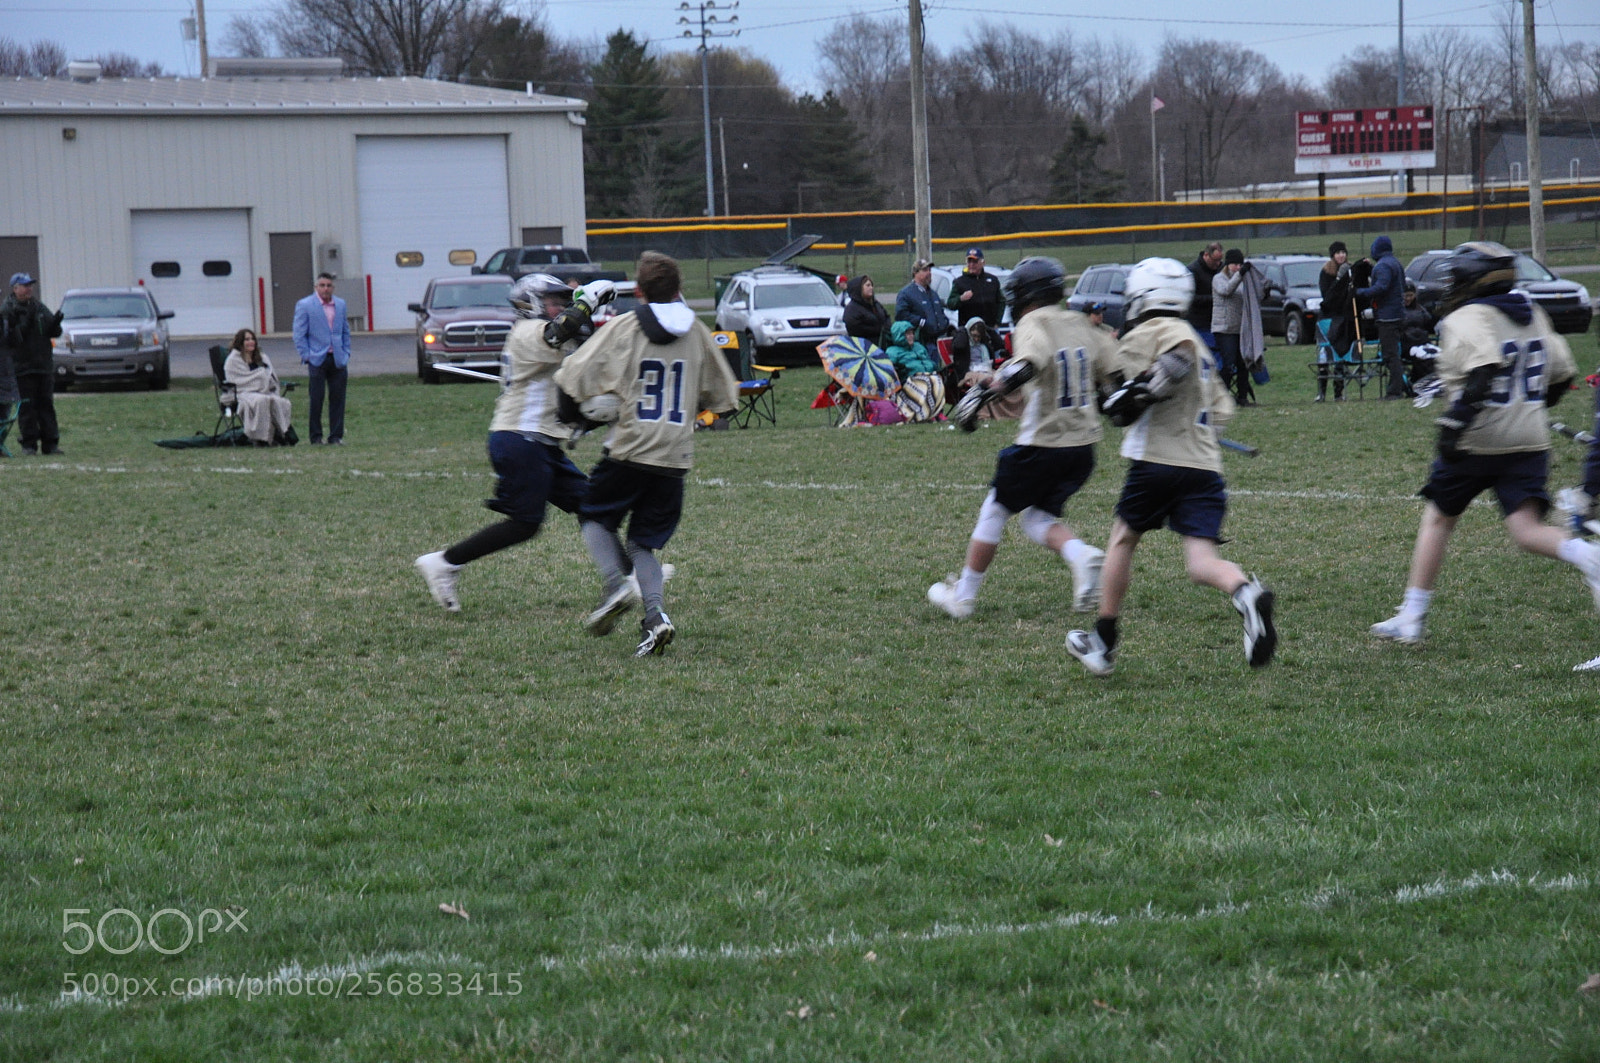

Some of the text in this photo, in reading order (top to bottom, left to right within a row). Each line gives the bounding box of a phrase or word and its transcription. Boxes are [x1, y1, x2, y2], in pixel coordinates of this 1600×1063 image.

[1303, 114, 1319, 124] BALL
[1332, 113, 1354, 122] STRIKE
[1375, 111, 1388, 120] OUT
[1301, 132, 1325, 143] GUEST
[636, 358, 687, 426] 31
